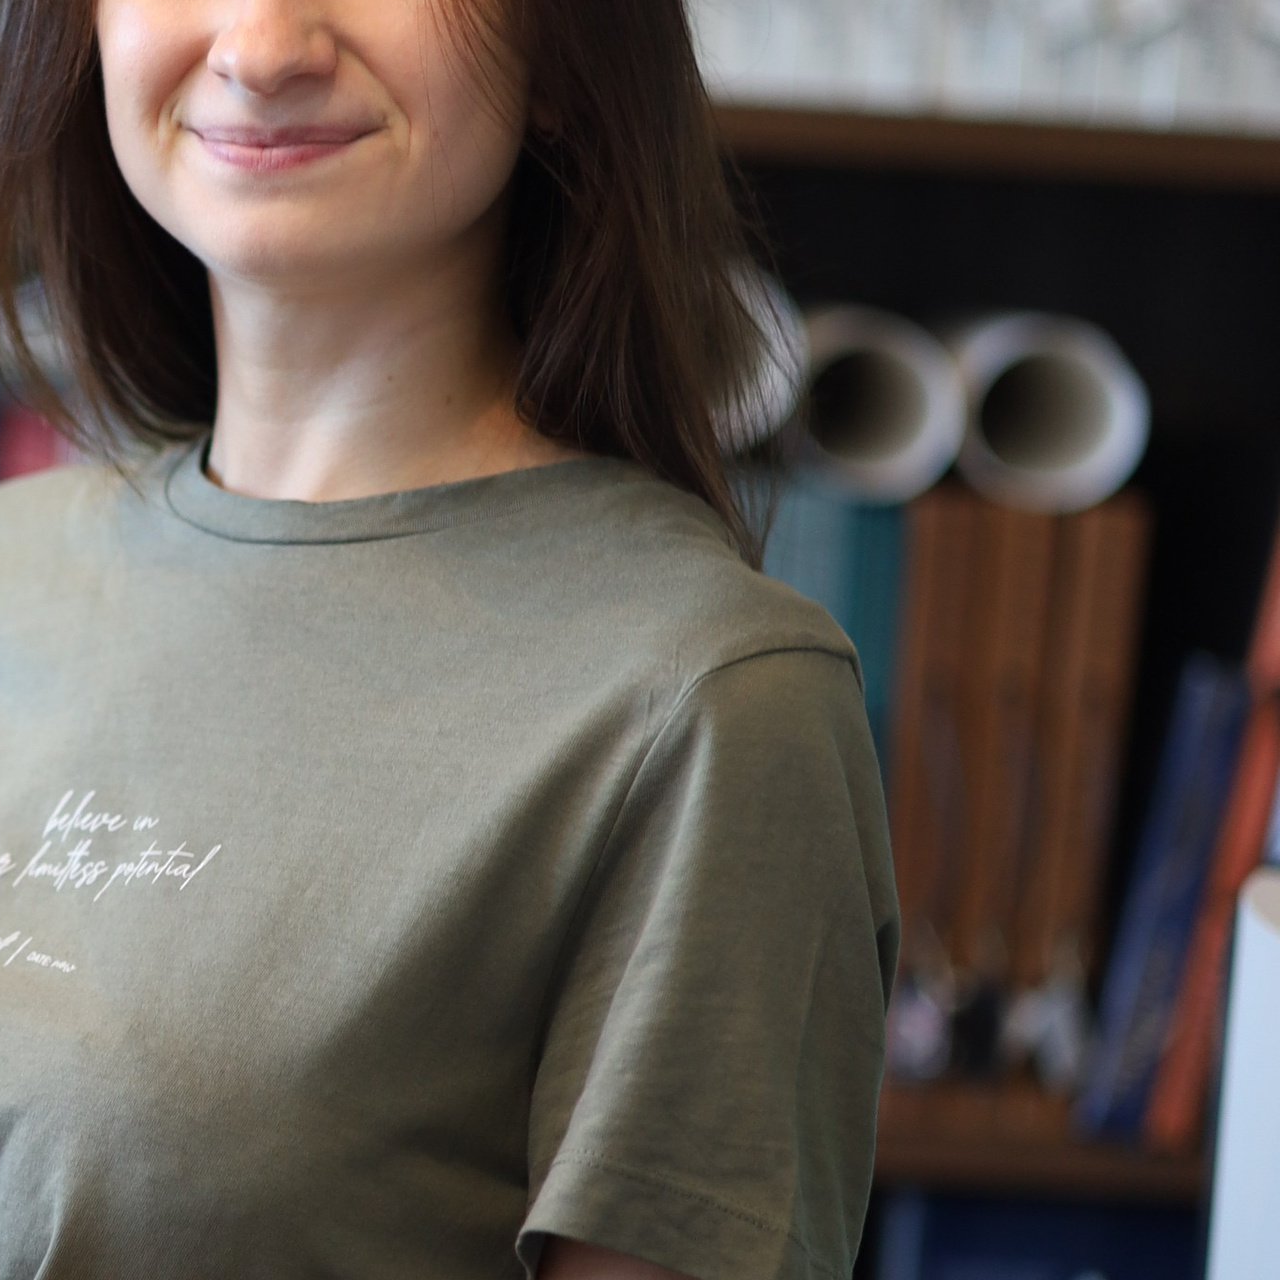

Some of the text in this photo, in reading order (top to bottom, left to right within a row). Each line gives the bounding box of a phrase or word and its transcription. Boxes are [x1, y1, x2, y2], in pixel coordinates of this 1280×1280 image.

[42, 789, 159, 842] believe in
[12, 839, 108, 892] limitless
[93, 840, 222, 902] potential
